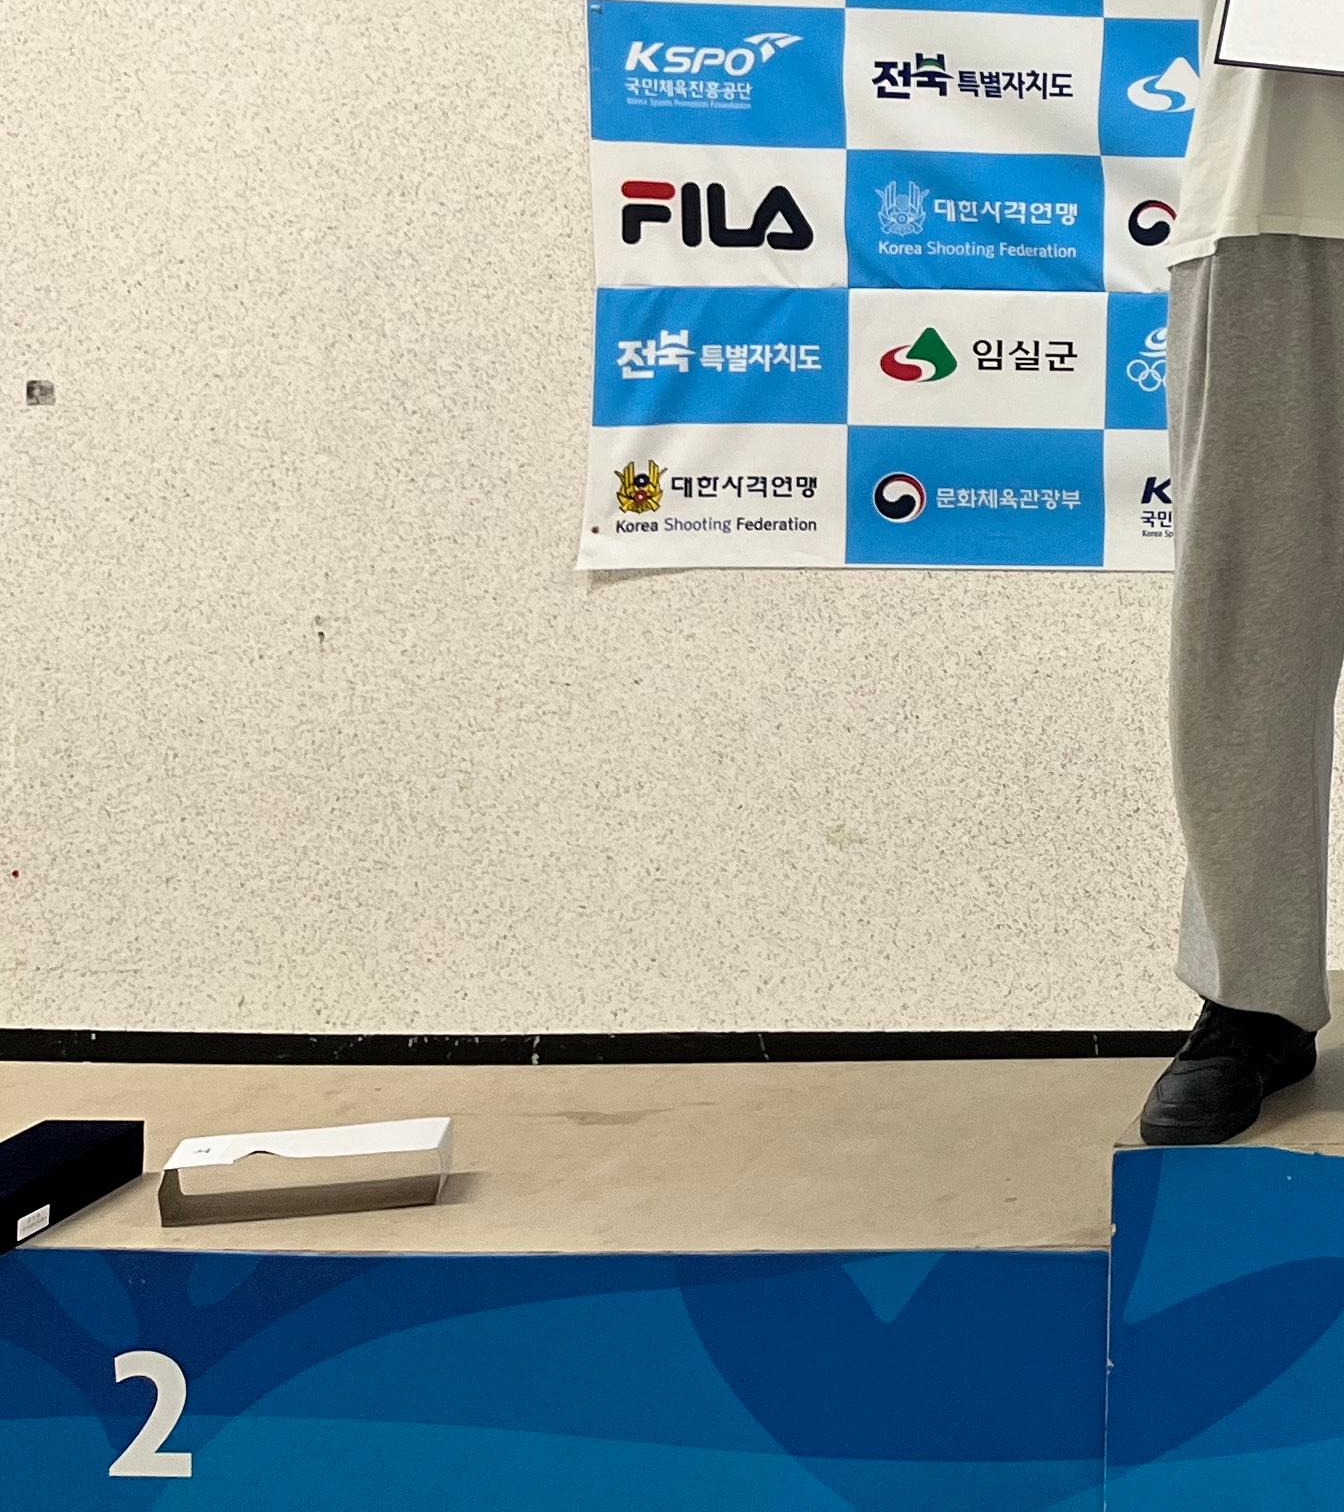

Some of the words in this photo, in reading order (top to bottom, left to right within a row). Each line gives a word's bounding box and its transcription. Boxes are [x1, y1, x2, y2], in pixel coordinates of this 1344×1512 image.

[624, 42, 754, 76] KSPO
[624, 77, 753, 101] 국민체육진흥공단
[957, 70, 1073, 100] 특별자치도
[621, 181, 813, 249] FILA
[934, 198, 1077, 224] 대한사격연맹
[879, 241, 922, 256] Korea
[926, 241, 994, 259] Shooting
[1000, 242, 1076, 259] Federation
[700, 343, 821, 372] 특별자치도
[973, 339, 1079, 373] 임실군
[671, 475, 817, 501] 대한사격연맹
[937, 487, 1081, 511] 문화체육관광부
[615, 516, 659, 533] Korea
[664, 515, 731, 534] Shooting
[736, 515, 817, 533] Federation
[109, 1350, 192, 1477] 2
